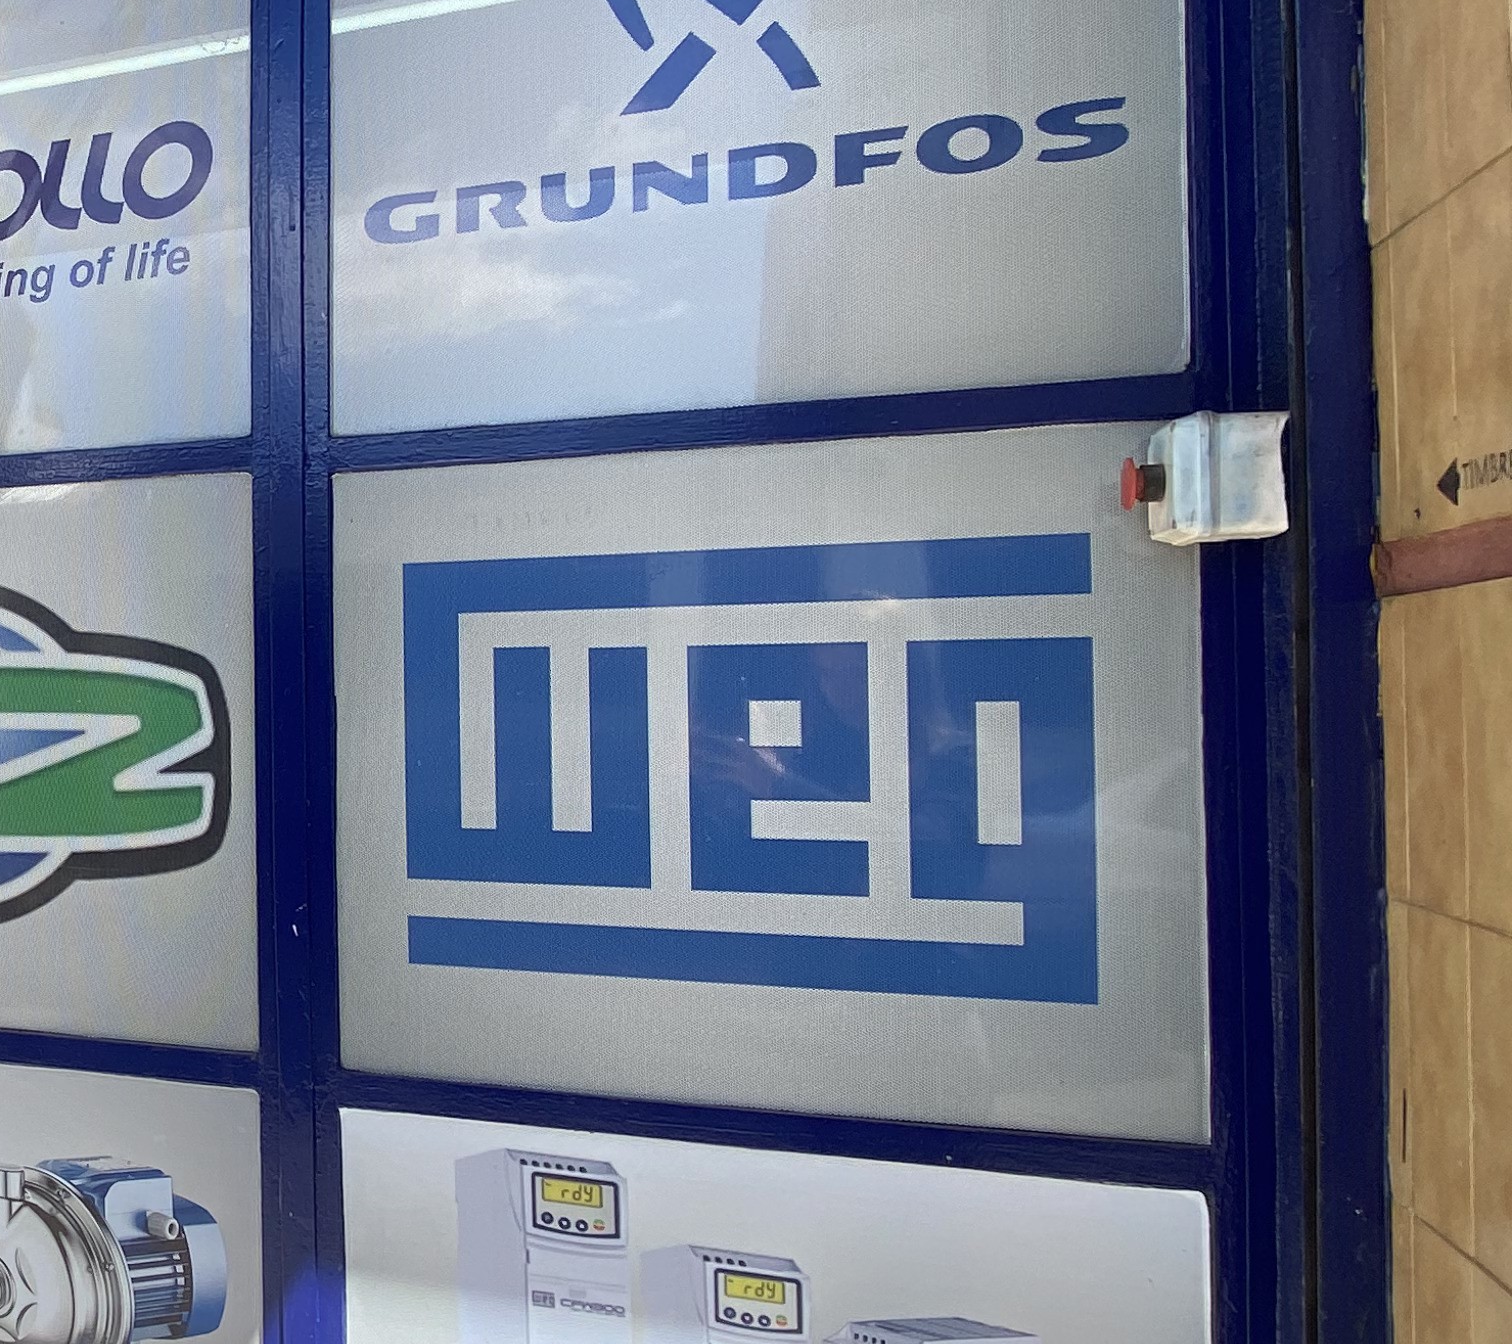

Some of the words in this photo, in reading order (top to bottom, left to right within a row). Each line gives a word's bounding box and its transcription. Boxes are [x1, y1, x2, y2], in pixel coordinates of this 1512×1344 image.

[364, 97, 1129, 245] GRUNDFOS
[69, 239, 115, 290] of
[125, 236, 190, 282] life
